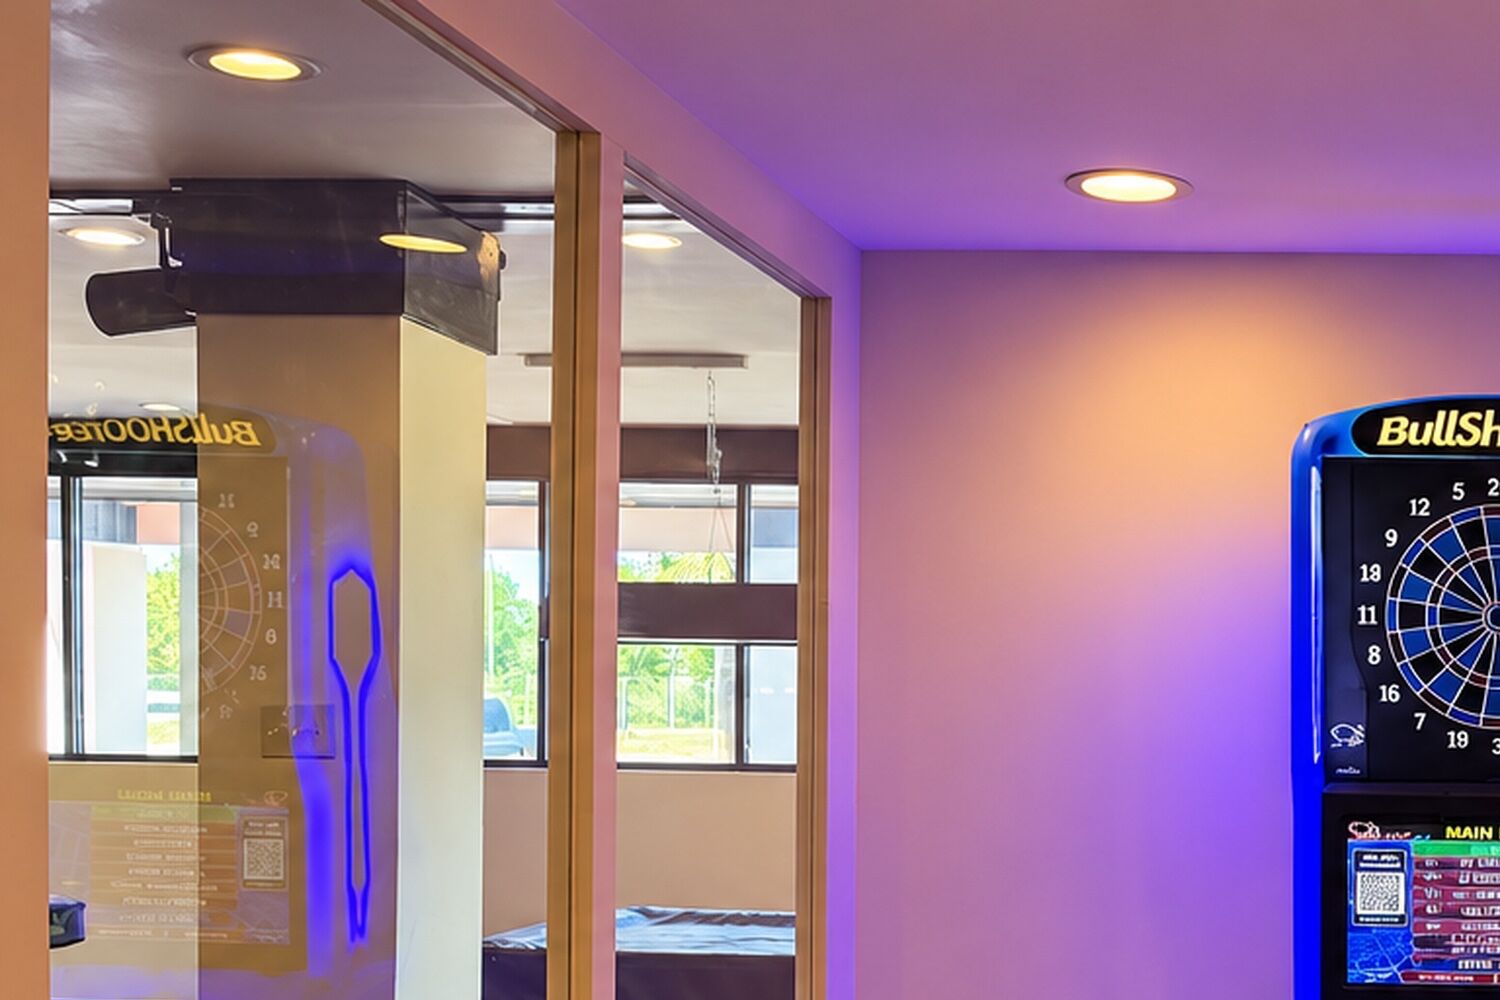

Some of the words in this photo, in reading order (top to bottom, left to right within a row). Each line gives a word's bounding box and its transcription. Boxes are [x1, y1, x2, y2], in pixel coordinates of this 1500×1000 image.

[1452, 481, 1465, 501] 5
[1409, 497, 1431, 517] 12
[1384, 528, 1398, 548] 9
[1357, 604, 1378, 625] 11
[1367, 644, 1382, 665] 8
[1379, 683, 1401, 703] 16
[1414, 712, 1427, 731] 7
[1445, 826, 1494, 841] MAIN
